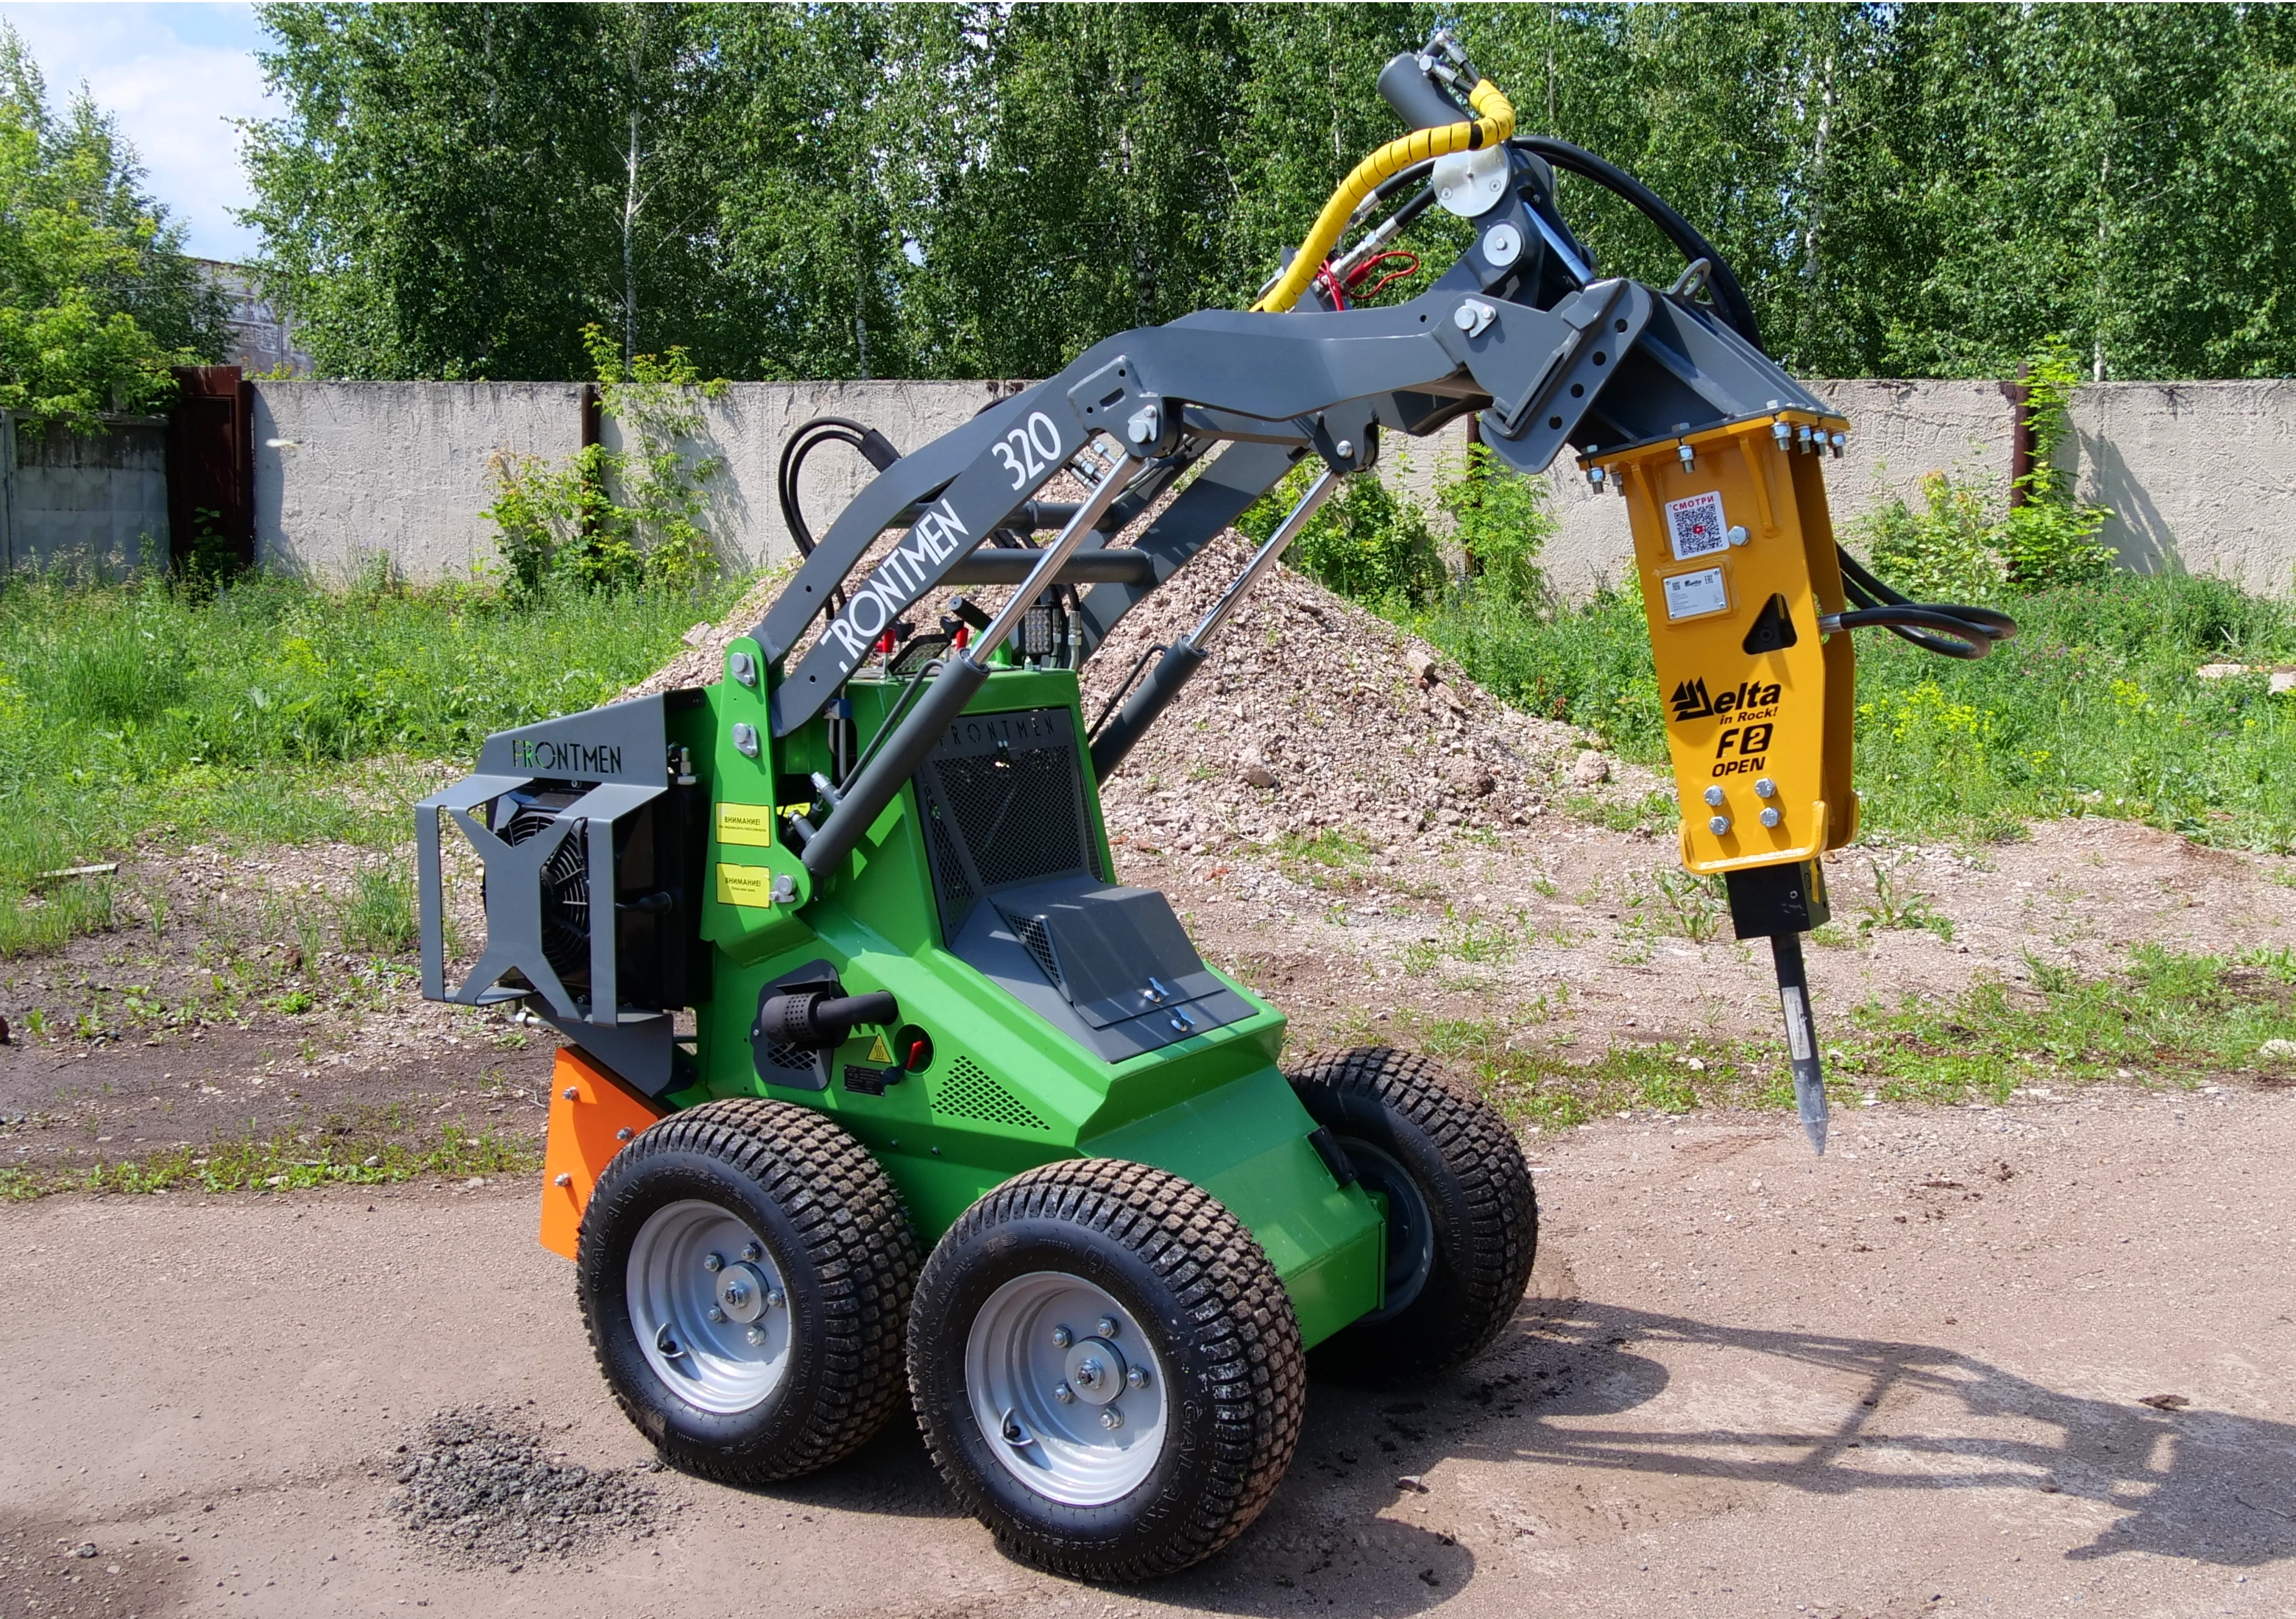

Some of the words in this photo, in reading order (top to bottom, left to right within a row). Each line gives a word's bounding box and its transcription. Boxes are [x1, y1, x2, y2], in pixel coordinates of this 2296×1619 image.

[991, 411, 1062, 492] 320
[1672, 495, 1715, 511] СМОТРИ
[1719, 715, 1732, 726] in
[1737, 706, 1779, 723] Rock!
[512, 740, 623, 775] FRONTMEN
[1711, 756, 1766, 778] OPEN
[724, 816, 760, 825] ВНИМАНИЕ!
[725, 877, 761, 887] ВНИМАНИЕ!
